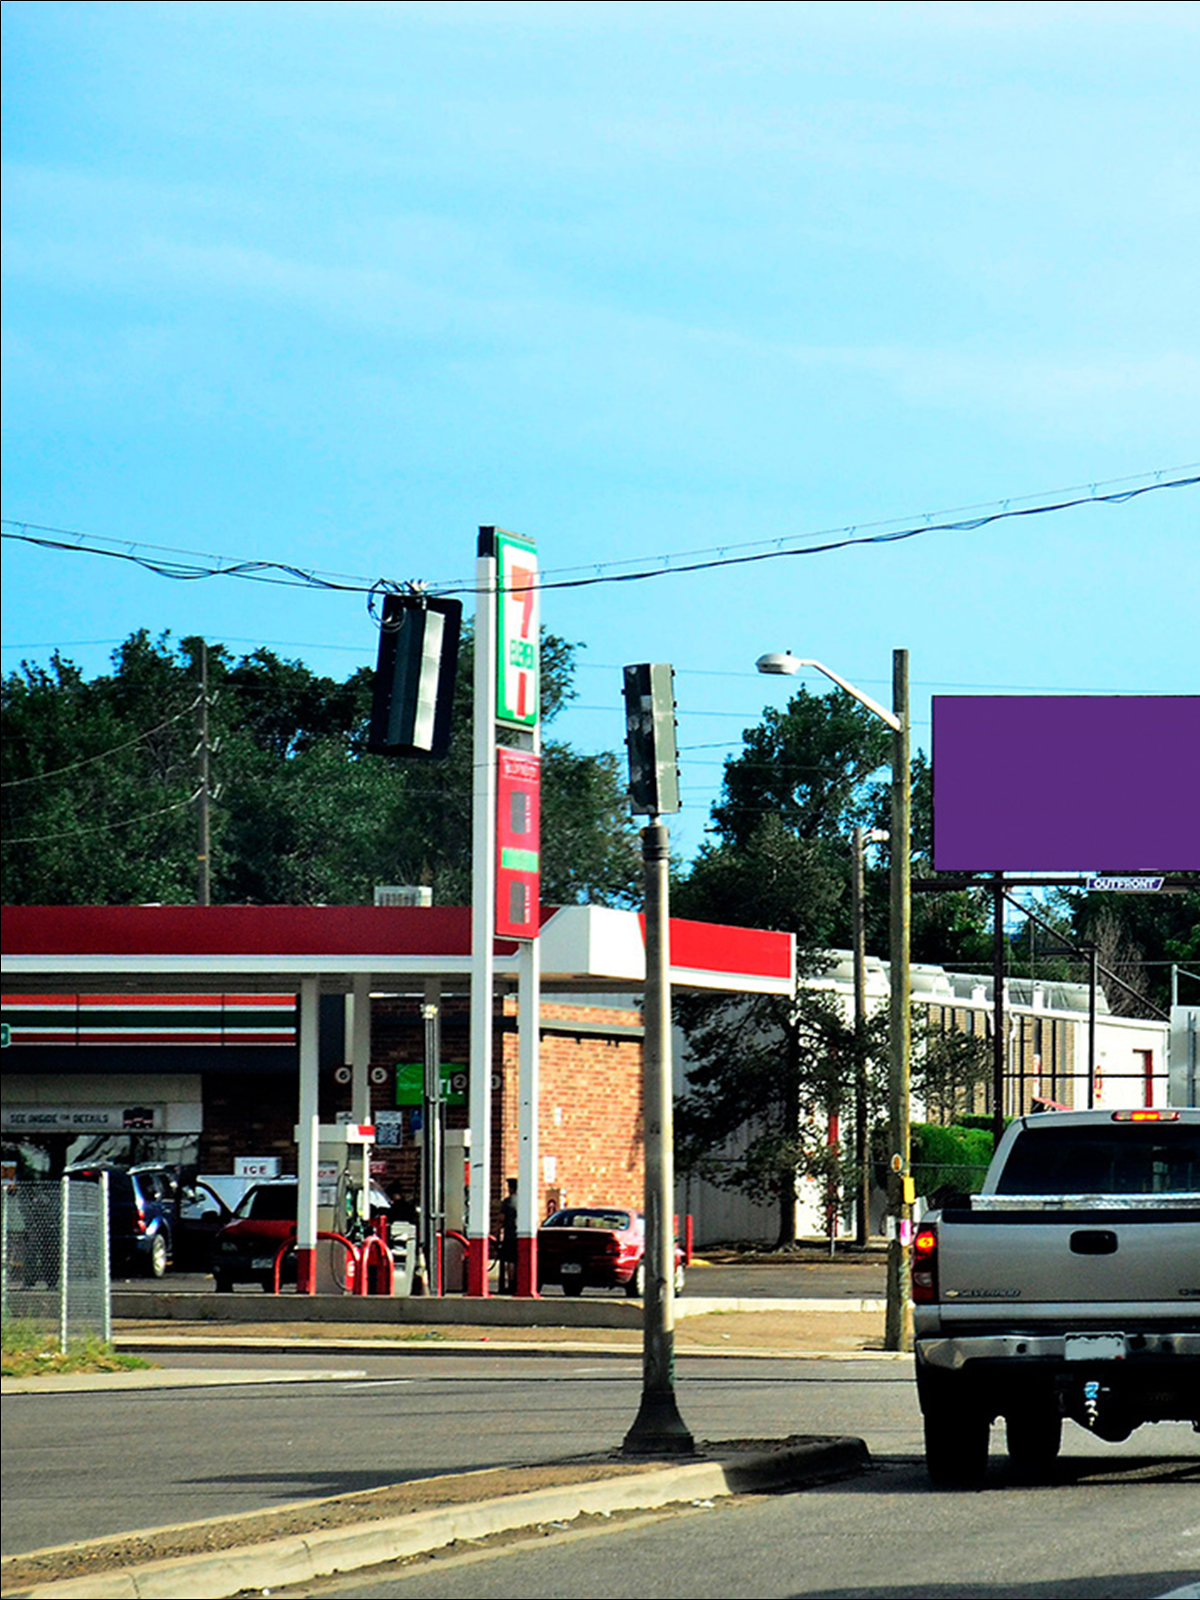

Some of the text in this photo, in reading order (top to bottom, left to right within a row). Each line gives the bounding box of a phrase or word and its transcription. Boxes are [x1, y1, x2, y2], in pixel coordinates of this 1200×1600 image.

[1093, 879, 1158, 889] OUTFRONT
[73, 1114, 108, 1124] DETAILS
[243, 1165, 267, 1174] ICE
